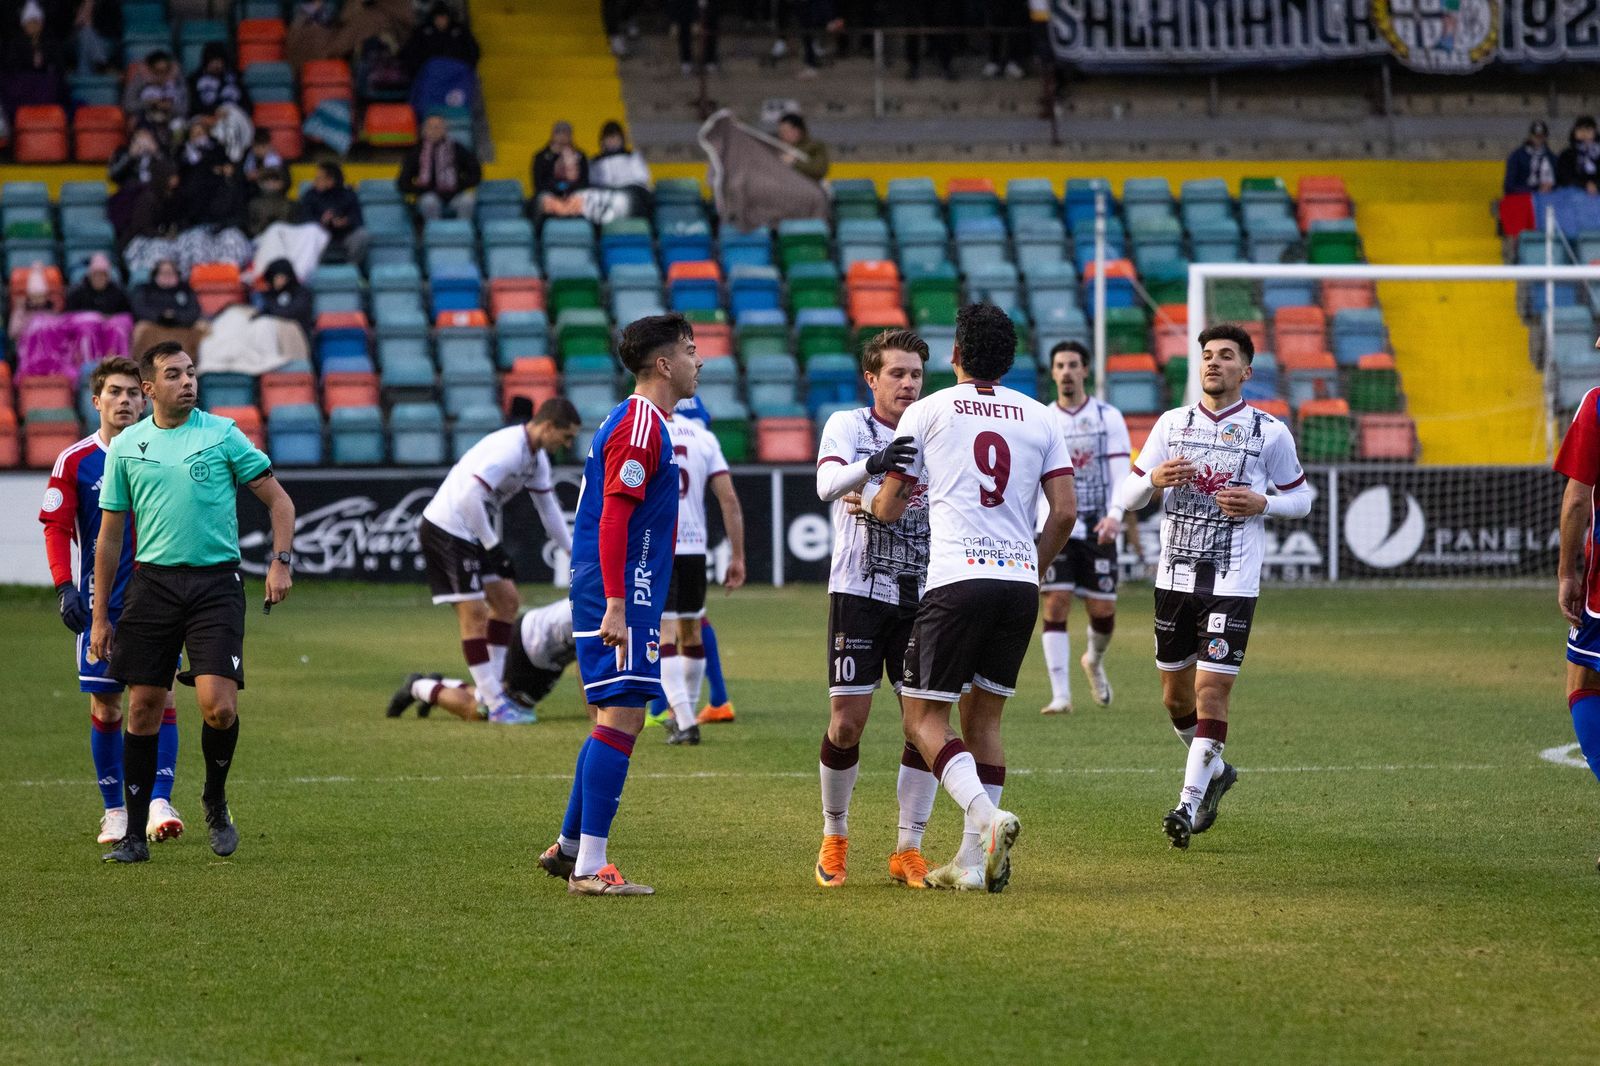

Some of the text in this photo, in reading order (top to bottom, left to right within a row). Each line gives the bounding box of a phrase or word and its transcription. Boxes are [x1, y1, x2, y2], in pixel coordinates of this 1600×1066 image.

[953, 399, 1025, 422] SERVETTI
[973, 430, 1011, 508] 9
[633, 529, 652, 607] PJR Gestión
[834, 655, 856, 683] 10
